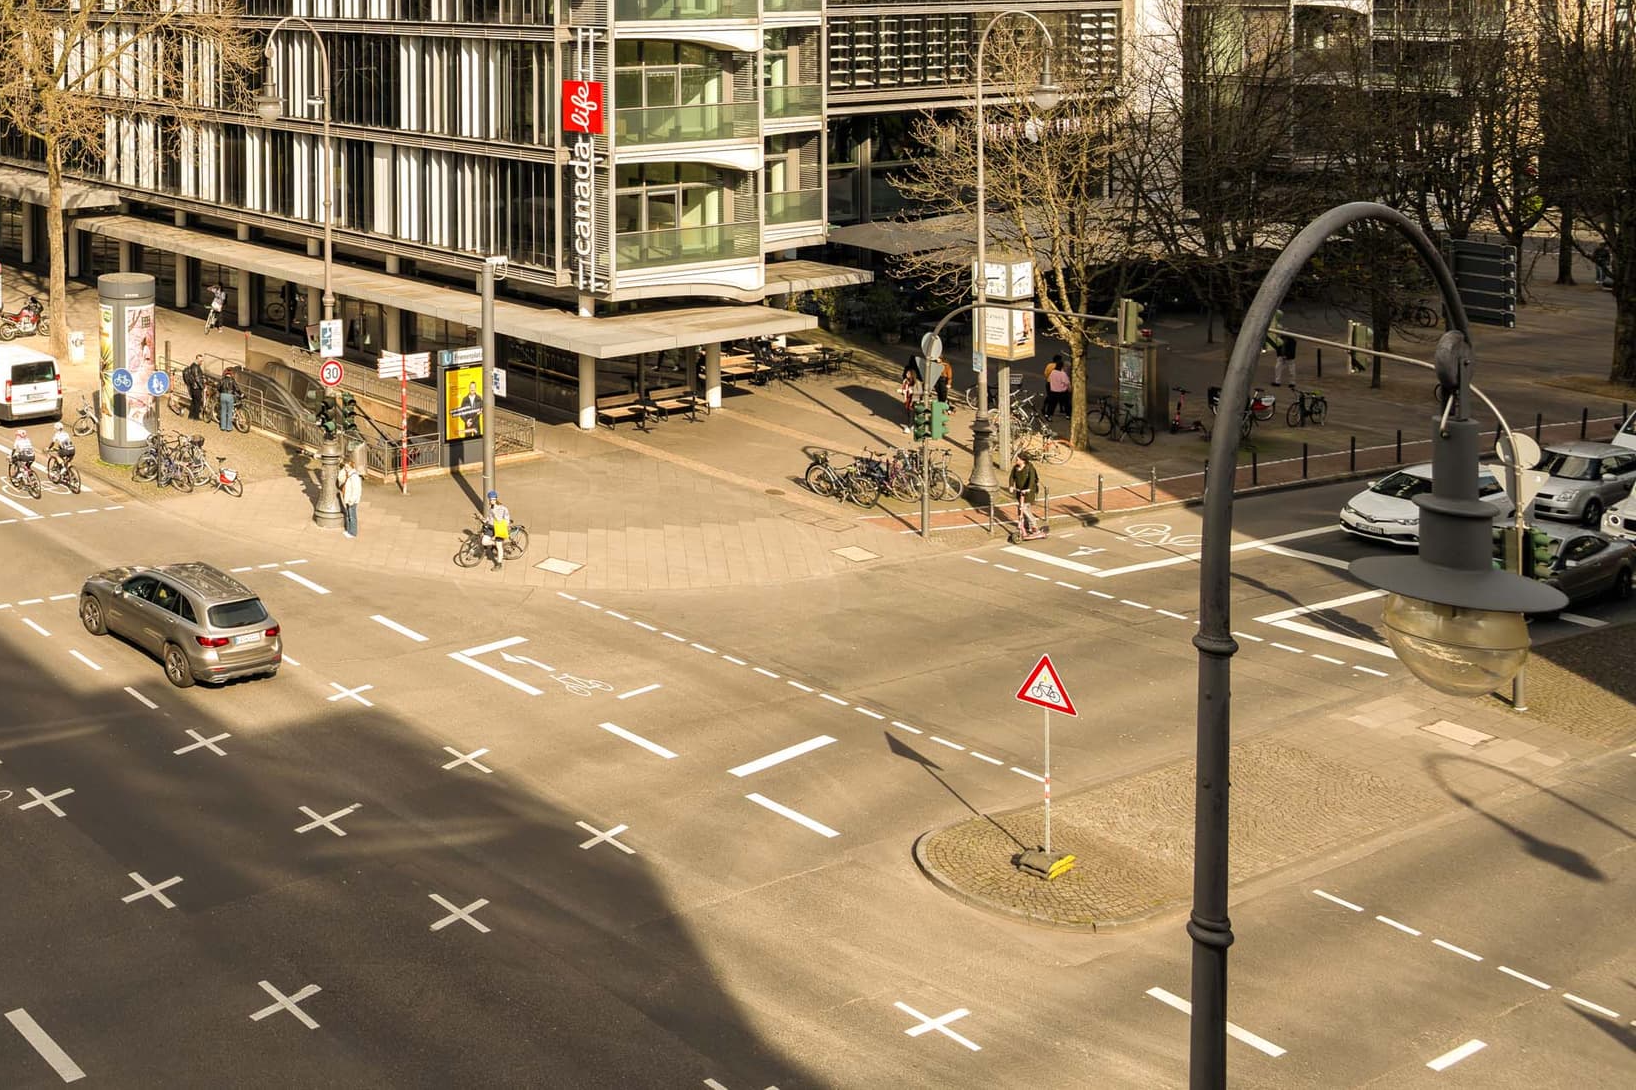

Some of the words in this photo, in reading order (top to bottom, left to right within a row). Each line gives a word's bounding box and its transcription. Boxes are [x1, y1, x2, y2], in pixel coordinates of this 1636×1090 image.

[570, 81, 598, 133] life
[568, 142, 591, 256] canada
[325, 367, 339, 380] 30
